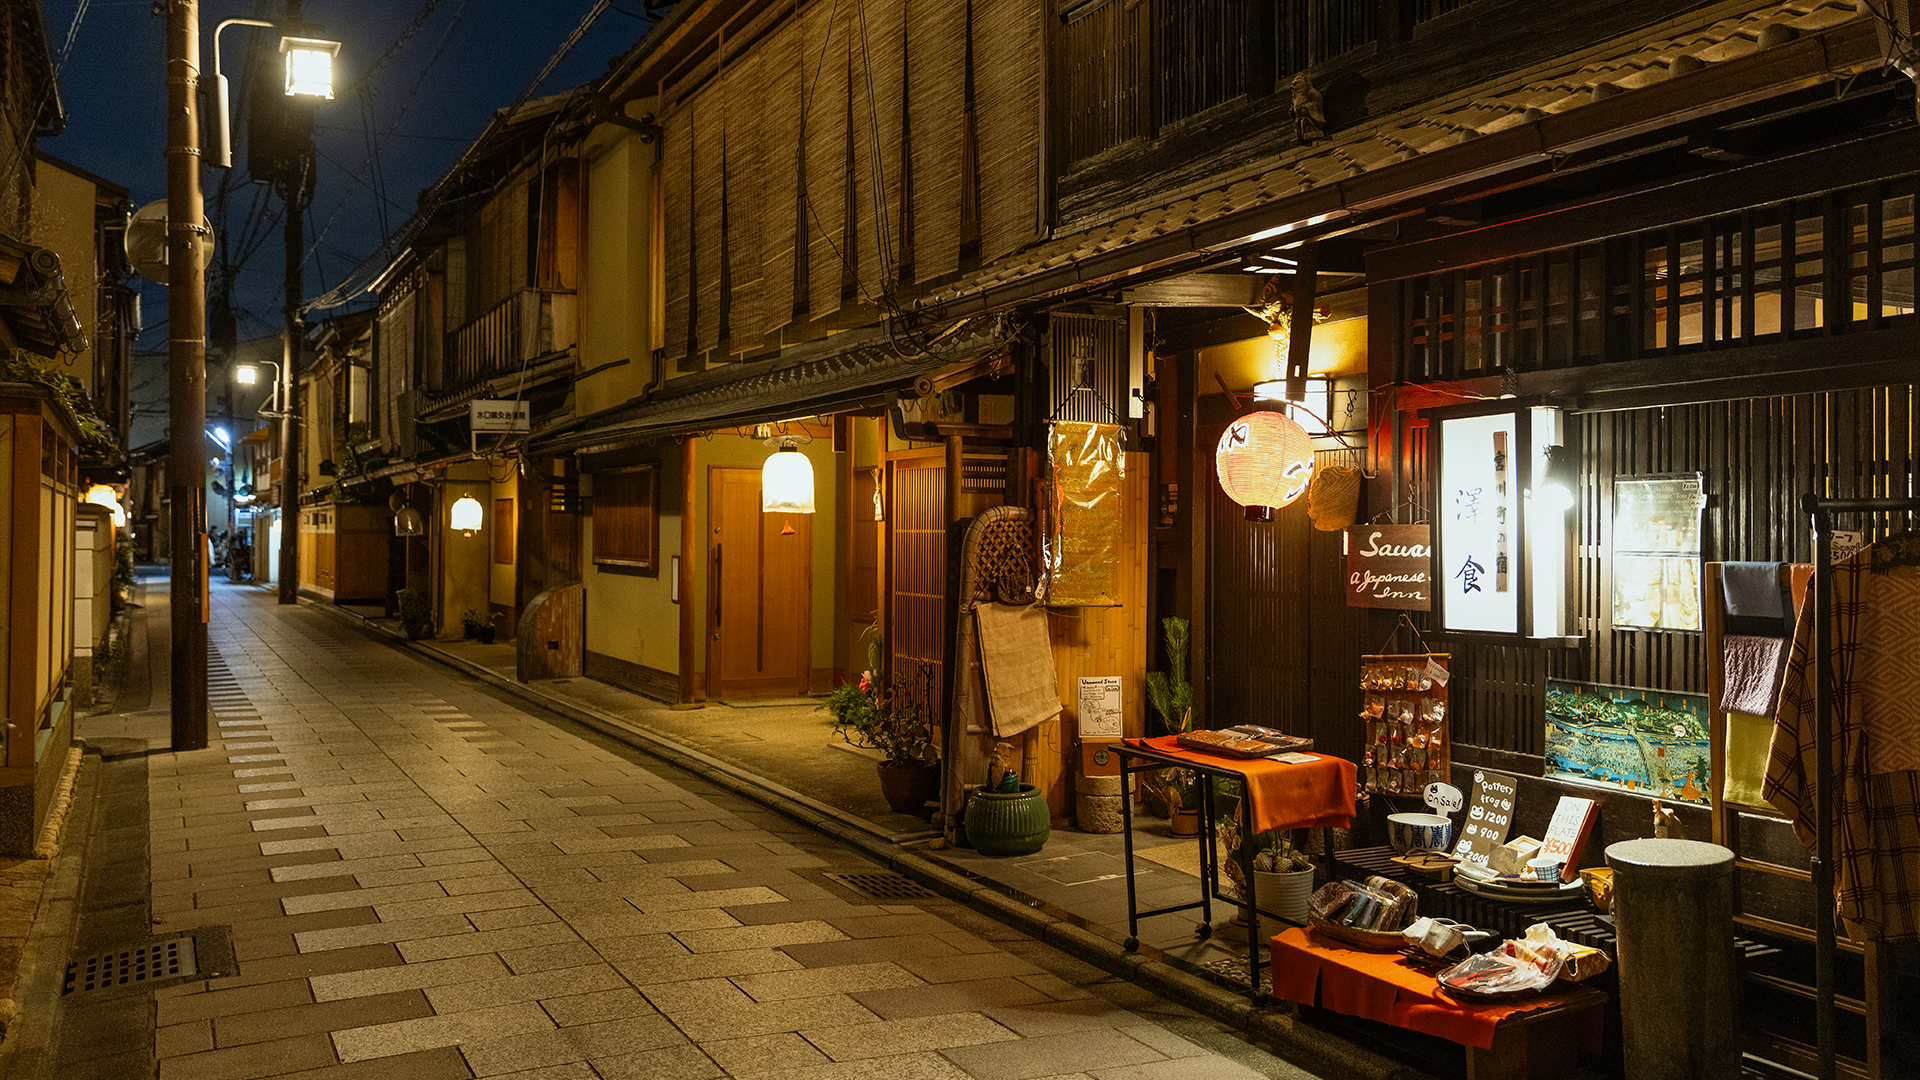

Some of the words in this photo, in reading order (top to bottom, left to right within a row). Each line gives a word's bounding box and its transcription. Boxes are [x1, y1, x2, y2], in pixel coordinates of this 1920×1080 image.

[1356, 570, 1426, 593] Japanese
[1440, 796, 1462, 810] Sale!
[1480, 794, 1500, 808] frog
[1564, 802, 1582, 812] ON
[1484, 811, 1508, 826] 1200
[1556, 814, 1580, 826] THIS
[1480, 827, 1499, 840] 900
[1549, 826, 1578, 838] PLATE
[1544, 837, 1572, 856] ¥500
